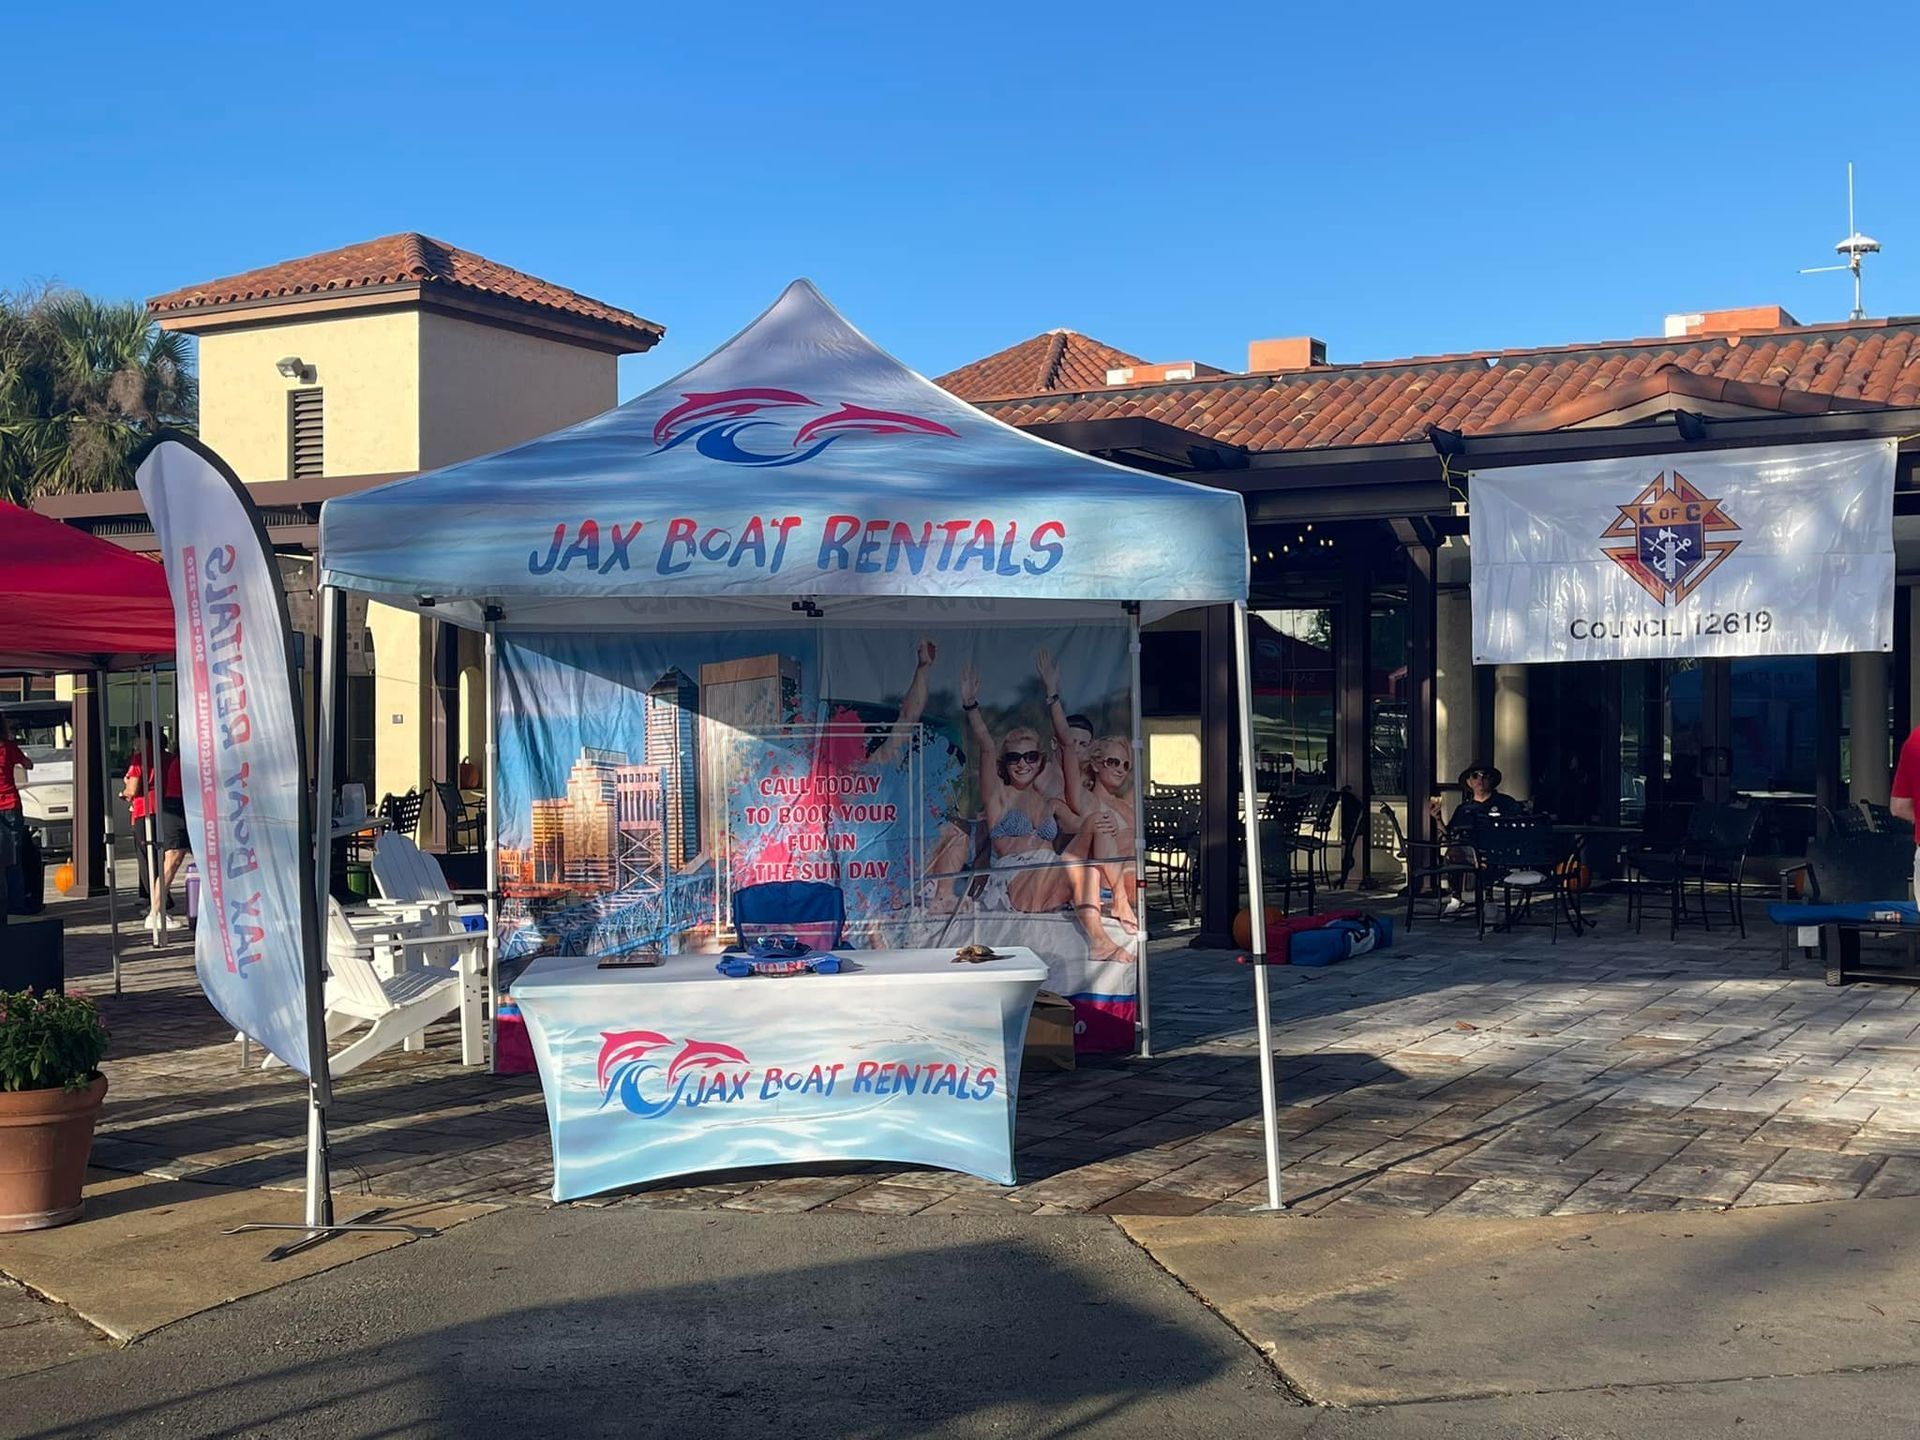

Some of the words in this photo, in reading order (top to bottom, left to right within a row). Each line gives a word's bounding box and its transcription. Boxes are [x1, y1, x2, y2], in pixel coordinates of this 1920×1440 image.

[1639, 507, 1653, 524] K
[1659, 508, 1678, 520] OF
[1686, 503, 1701, 521] C
[528, 519, 643, 575] JAX
[656, 516, 801, 575] BOAT
[817, 515, 1066, 576] RENTALS
[1570, 619, 1682, 640] COUNCIL
[1696, 611, 1772, 635] 12619
[759, 777, 811, 796] CALL
[815, 776, 881, 794] TODAY
[745, 806, 771, 825] TO
[778, 805, 834, 824] BOOK
[841, 804, 897, 822] YOUR
[787, 833, 830, 852] FUN
[834, 833, 856, 851] IN
[754, 862, 794, 881] THE
[801, 862, 841, 880] SUN
[849, 861, 889, 880] DAY
[686, 1070, 750, 1107] JAX
[760, 1067, 844, 1101] BOAT
[853, 1061, 997, 1101] RENTALS
